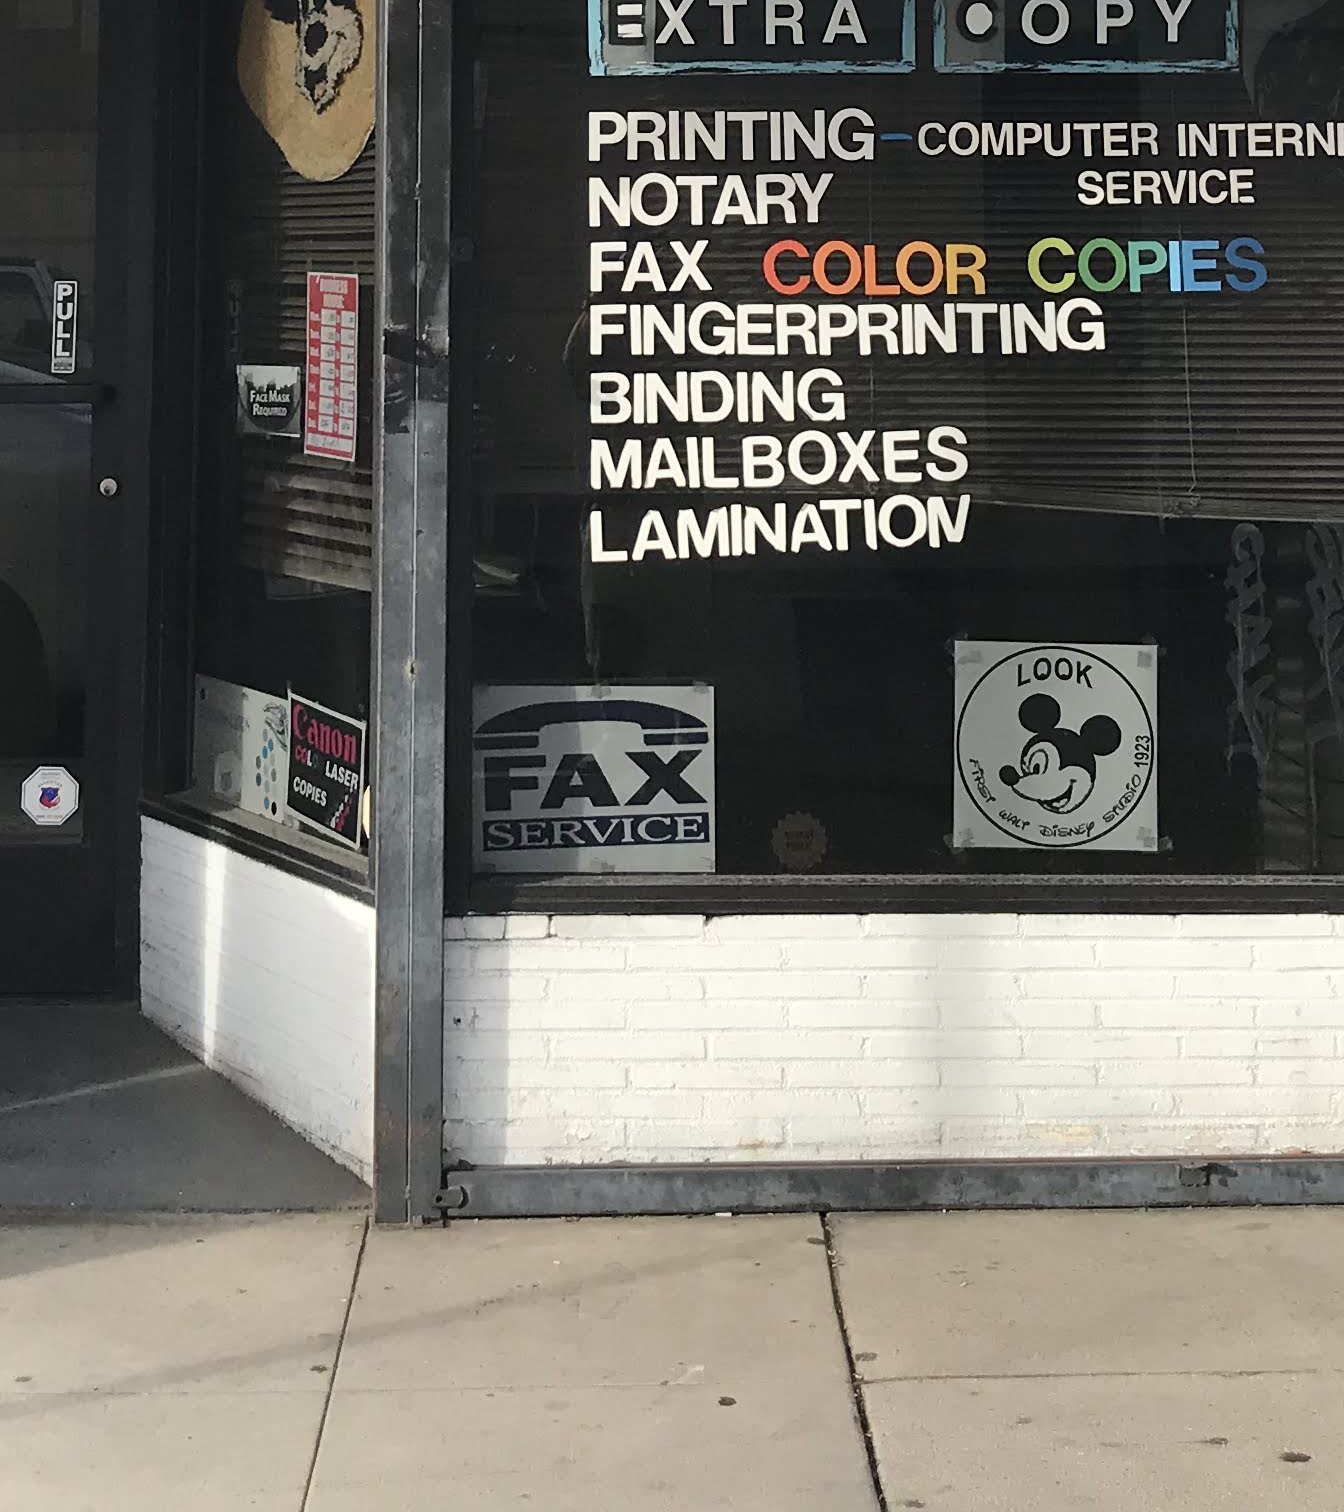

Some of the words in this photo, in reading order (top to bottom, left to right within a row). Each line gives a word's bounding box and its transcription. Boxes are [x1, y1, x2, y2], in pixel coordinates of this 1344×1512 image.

[588, 108, 876, 161] PRINTING
[917, 122, 1160, 157] COMPUTER
[588, 173, 834, 227] NOTARY
[1077, 169, 1256, 206] SERVICE
[589, 240, 712, 292] FAX
[762, 240, 987, 296] COLOR
[1027, 237, 1269, 293] COPIES
[56, 284, 74, 357] PULL
[589, 298, 1106, 356] FINGERPRINTING
[589, 367, 846, 425] BINDING
[589, 426, 969, 490] MAILBOXES
[589, 494, 971, 564] LAMINATION
[1017, 657, 1093, 688] LOOK
[292, 702, 357, 765] Canon
[1133, 734, 1151, 769] 1923
[293, 775, 328, 808] COPIES
[325, 760, 360, 794] LASER
[482, 749, 710, 812] FAX
[486, 815, 706, 850] SERVICE
